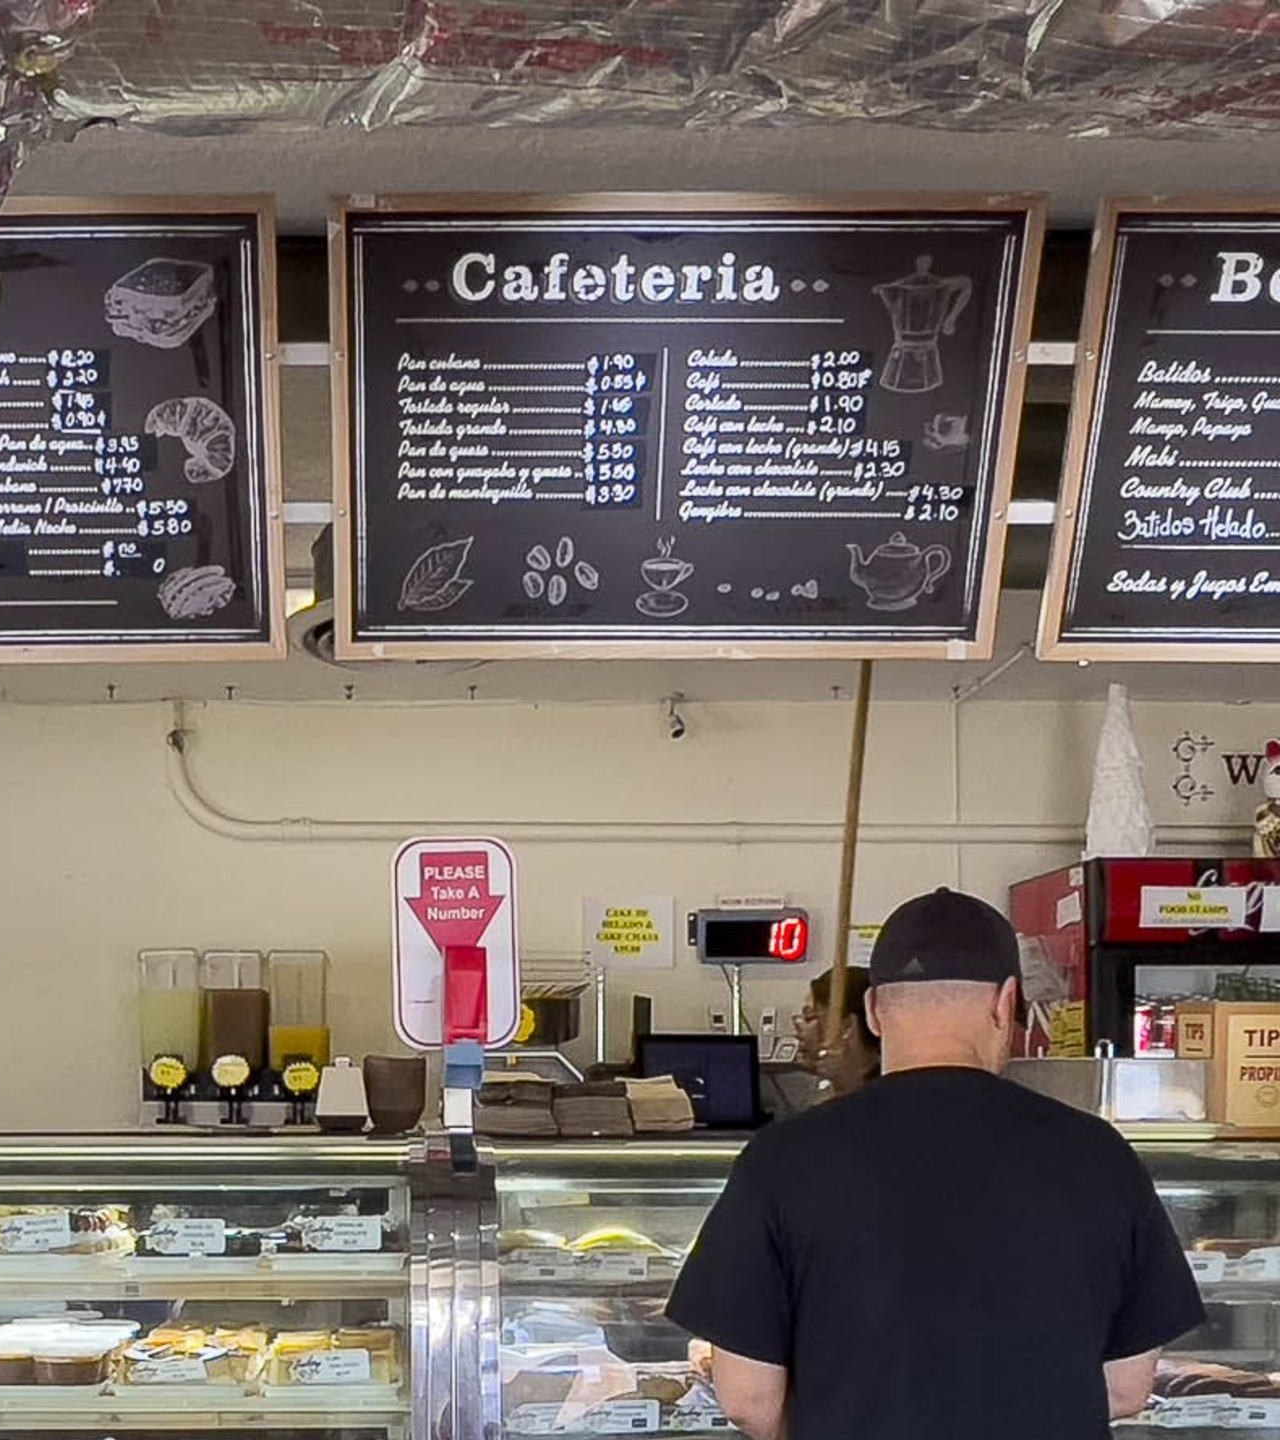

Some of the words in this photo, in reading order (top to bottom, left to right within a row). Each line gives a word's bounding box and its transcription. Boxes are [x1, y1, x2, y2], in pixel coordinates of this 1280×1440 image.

[452, 251, 781, 304] Cafeteria
[397, 352, 426, 371] Pan
[428, 352, 481, 370] cubano
[687, 349, 738, 368] Colada
[1136, 360, 1212, 384] Batidos
[397, 375, 427, 393] Pan
[428, 375, 447, 392] de
[448, 380, 486, 396] agua
[685, 372, 722, 395] Café
[399, 397, 454, 414] Tostada
[456, 397, 511, 419] regular
[684, 394, 743, 412] Cortado
[1132, 391, 1198, 416] Mamey,
[1202, 391, 1248, 416] Trigo,
[399, 418, 454, 437] Tostada
[455, 418, 508, 440] grande
[682, 415, 718, 438] Café
[718, 420, 745, 434] con
[746, 416, 785, 434] leche
[1128, 416, 1189, 441] Mango,
[1190, 416, 1253, 441] Papaya
[28, 434, 48, 452] de
[48, 439, 85, 456] agua
[397, 440, 426, 458] Pan
[428, 440, 447, 457] de
[449, 445, 489, 462] queso
[682, 438, 717, 460] Café
[717, 442, 744, 455] con
[745, 438, 783, 455] leche
[784, 438, 851, 460] (grande)
[1123, 445, 1180, 468] Mabi
[397, 462, 427, 479] Pan
[428, 466, 455, 479] con
[456, 461, 517, 483] guayaba
[531, 466, 572, 484] queso
[680, 459, 725, 477] Leche
[726, 463, 754, 477] con
[754, 459, 820, 477] chocolate
[397, 483, 426, 500] Pan
[428, 483, 447, 500] de
[448, 483, 534, 505] mantequilla
[679, 480, 724, 498] Leche
[725, 485, 751, 498] con
[752, 480, 818, 498] chocolate
[818, 480, 885, 502] (grande)
[1119, 476, 1201, 506] Country
[1202, 476, 1253, 500] Club
[32, 518, 77, 536] Noche
[1106, 569, 1169, 593] Sodas
[1168, 578, 1186, 600] y
[1185, 569, 1248, 600] Jugos
[423, 864, 486, 881] PLEASE
[430, 885, 465, 900] Take
[468, 885, 481, 899] A
[427, 907, 486, 920] Number
[769, 918, 802, 956] 10
